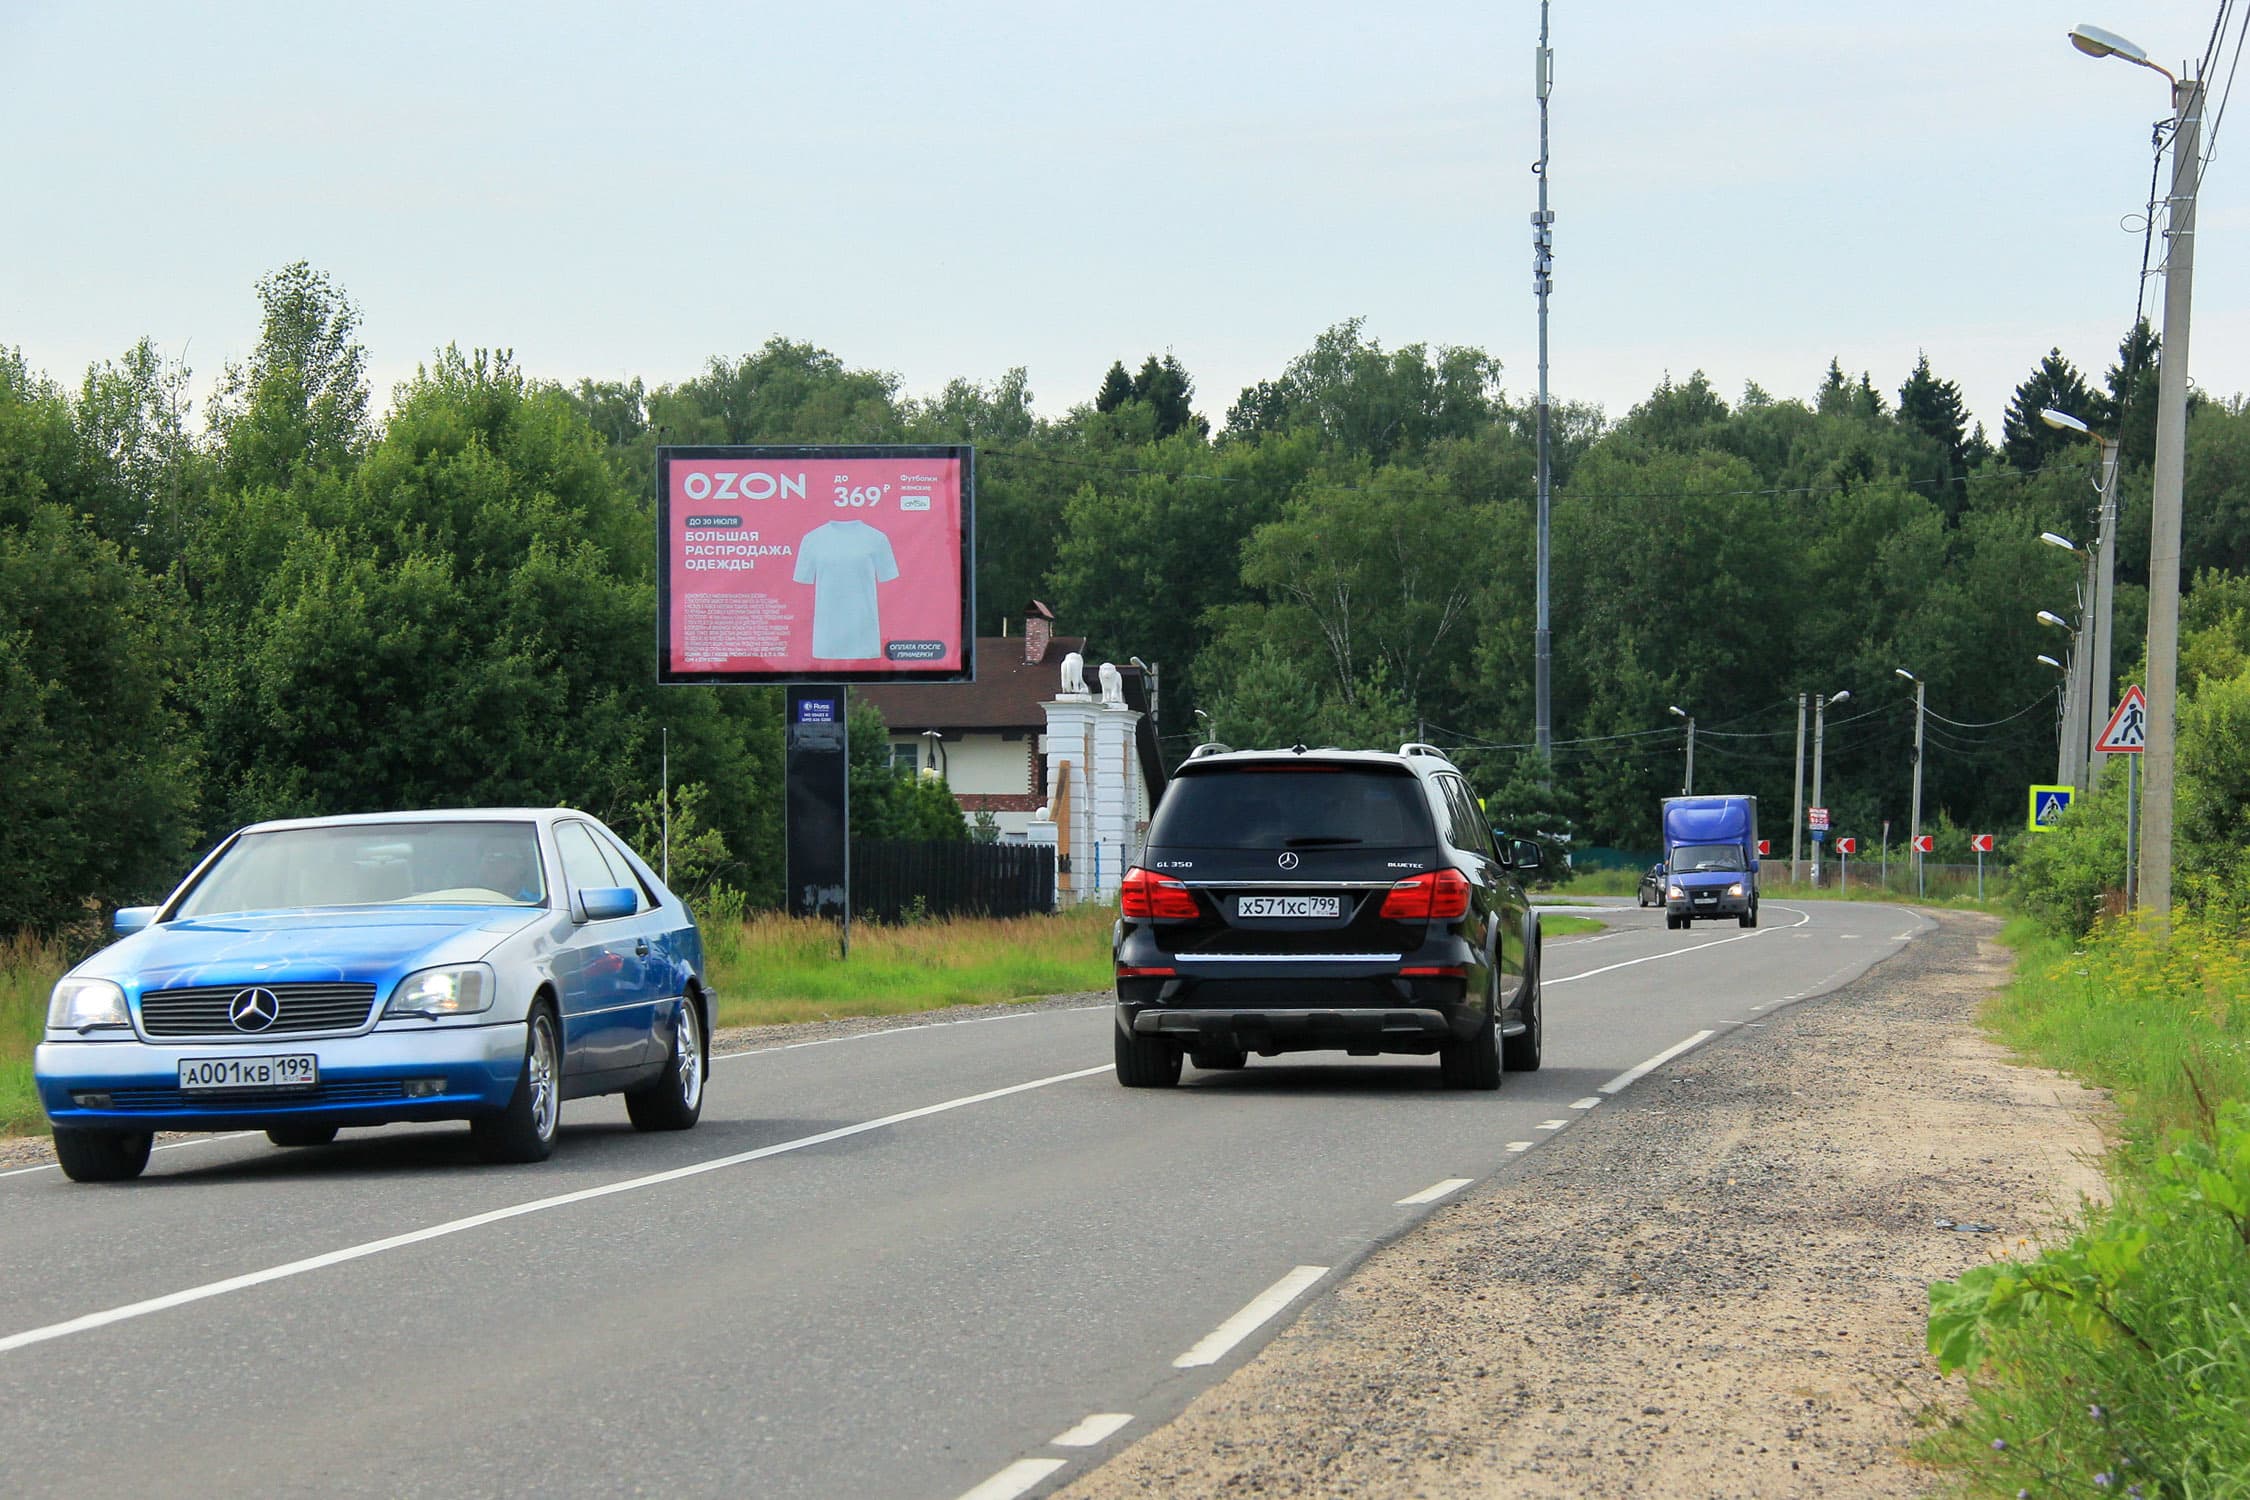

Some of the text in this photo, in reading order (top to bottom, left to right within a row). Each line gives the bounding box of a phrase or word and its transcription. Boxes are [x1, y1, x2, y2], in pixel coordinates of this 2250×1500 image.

[684, 472, 806, 499] OZON
[689, 518, 701, 526] ДО
[685, 531, 759, 541] БОЛЬШАЯ
[685, 545, 792, 557] РАСПРОДАЖА
[685, 559, 754, 571] ОДЕЖДЫ
[1311, 898, 1336, 910] 799
[276, 1059, 310, 1076] 199
